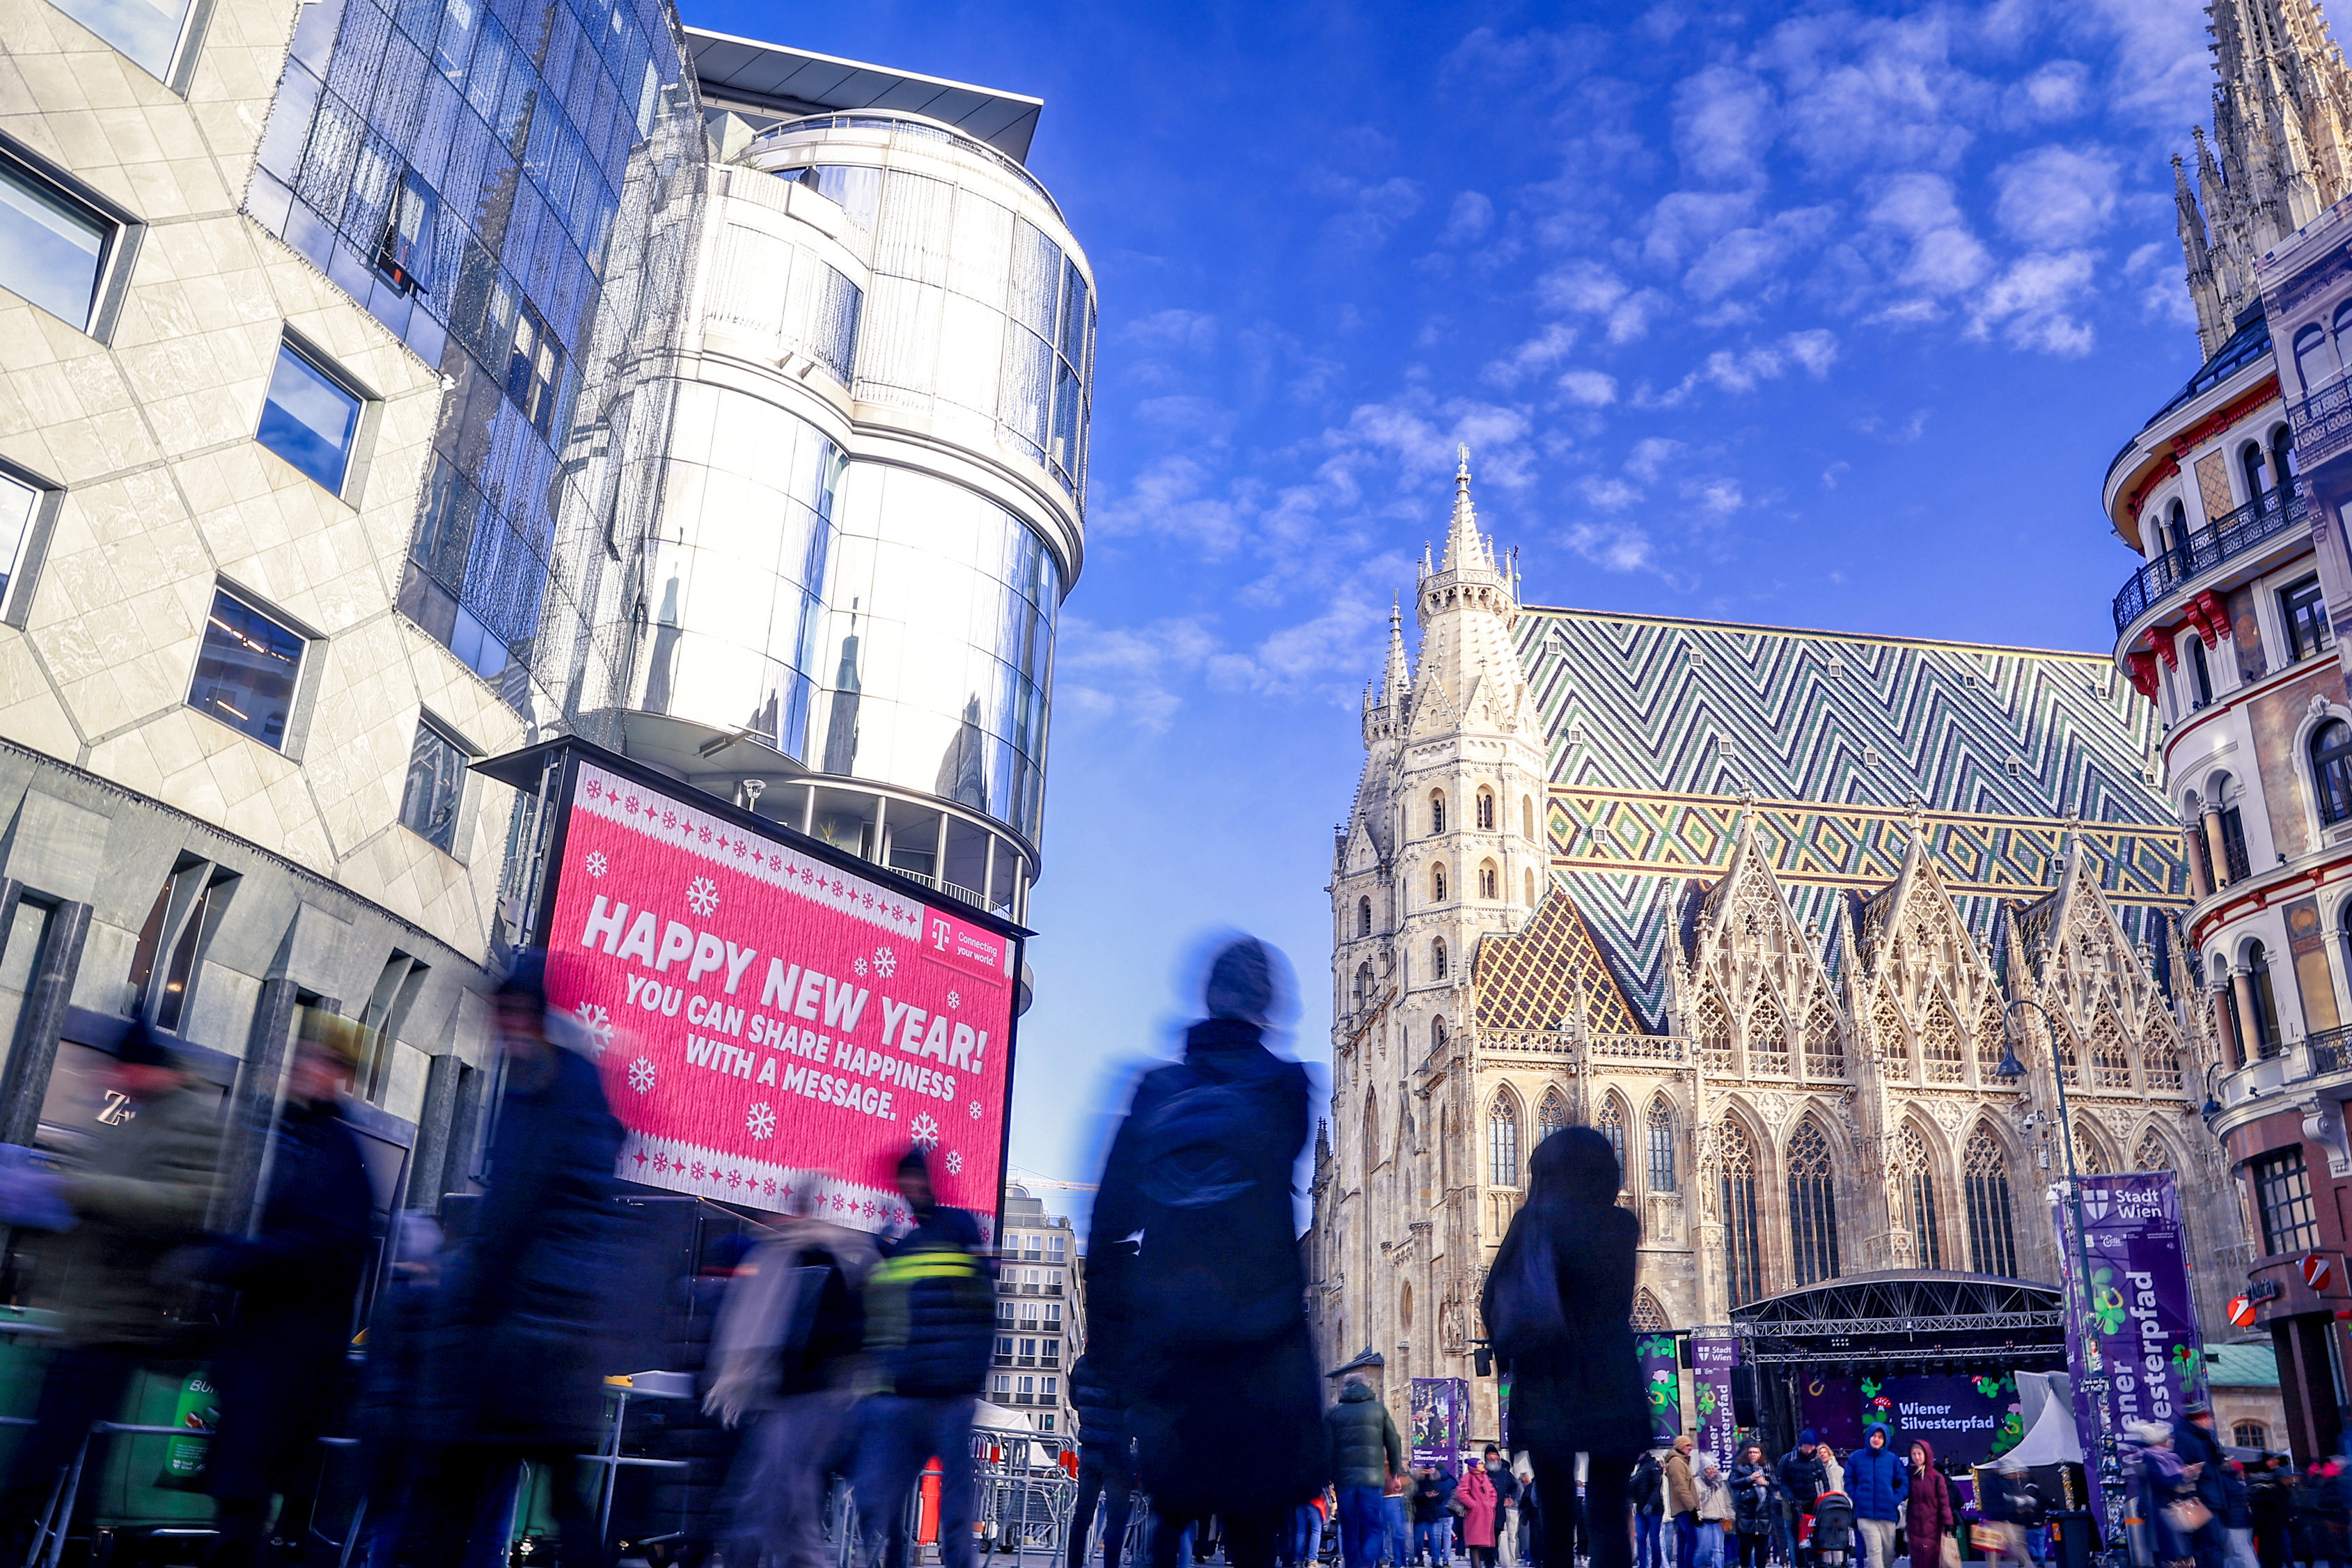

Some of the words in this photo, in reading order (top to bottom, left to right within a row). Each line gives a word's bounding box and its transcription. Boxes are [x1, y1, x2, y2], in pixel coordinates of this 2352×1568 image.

[958, 932, 997, 957] Connecting
[957, 946, 974, 958] your
[974, 952, 995, 966] world.
[581, 895, 758, 994] HAPPY
[760, 959, 870, 1034] NEW
[881, 996, 989, 1074] YEAR!
[626, 973, 683, 1017] YOU
[688, 995, 745, 1037] CAN
[748, 1015, 829, 1063] SHARE
[833, 1041, 956, 1101] HAPPINESS
[686, 1034, 753, 1079] WITH
[757, 1058, 777, 1088] A
[782, 1067, 897, 1121] MESSAGE.
[2115, 1189, 2158, 1202] Stadt
[2117, 1204, 2162, 1218] Wien
[1899, 1402, 1951, 1415] Wiener
[1901, 1416, 1994, 1432] Silvesterpfad
